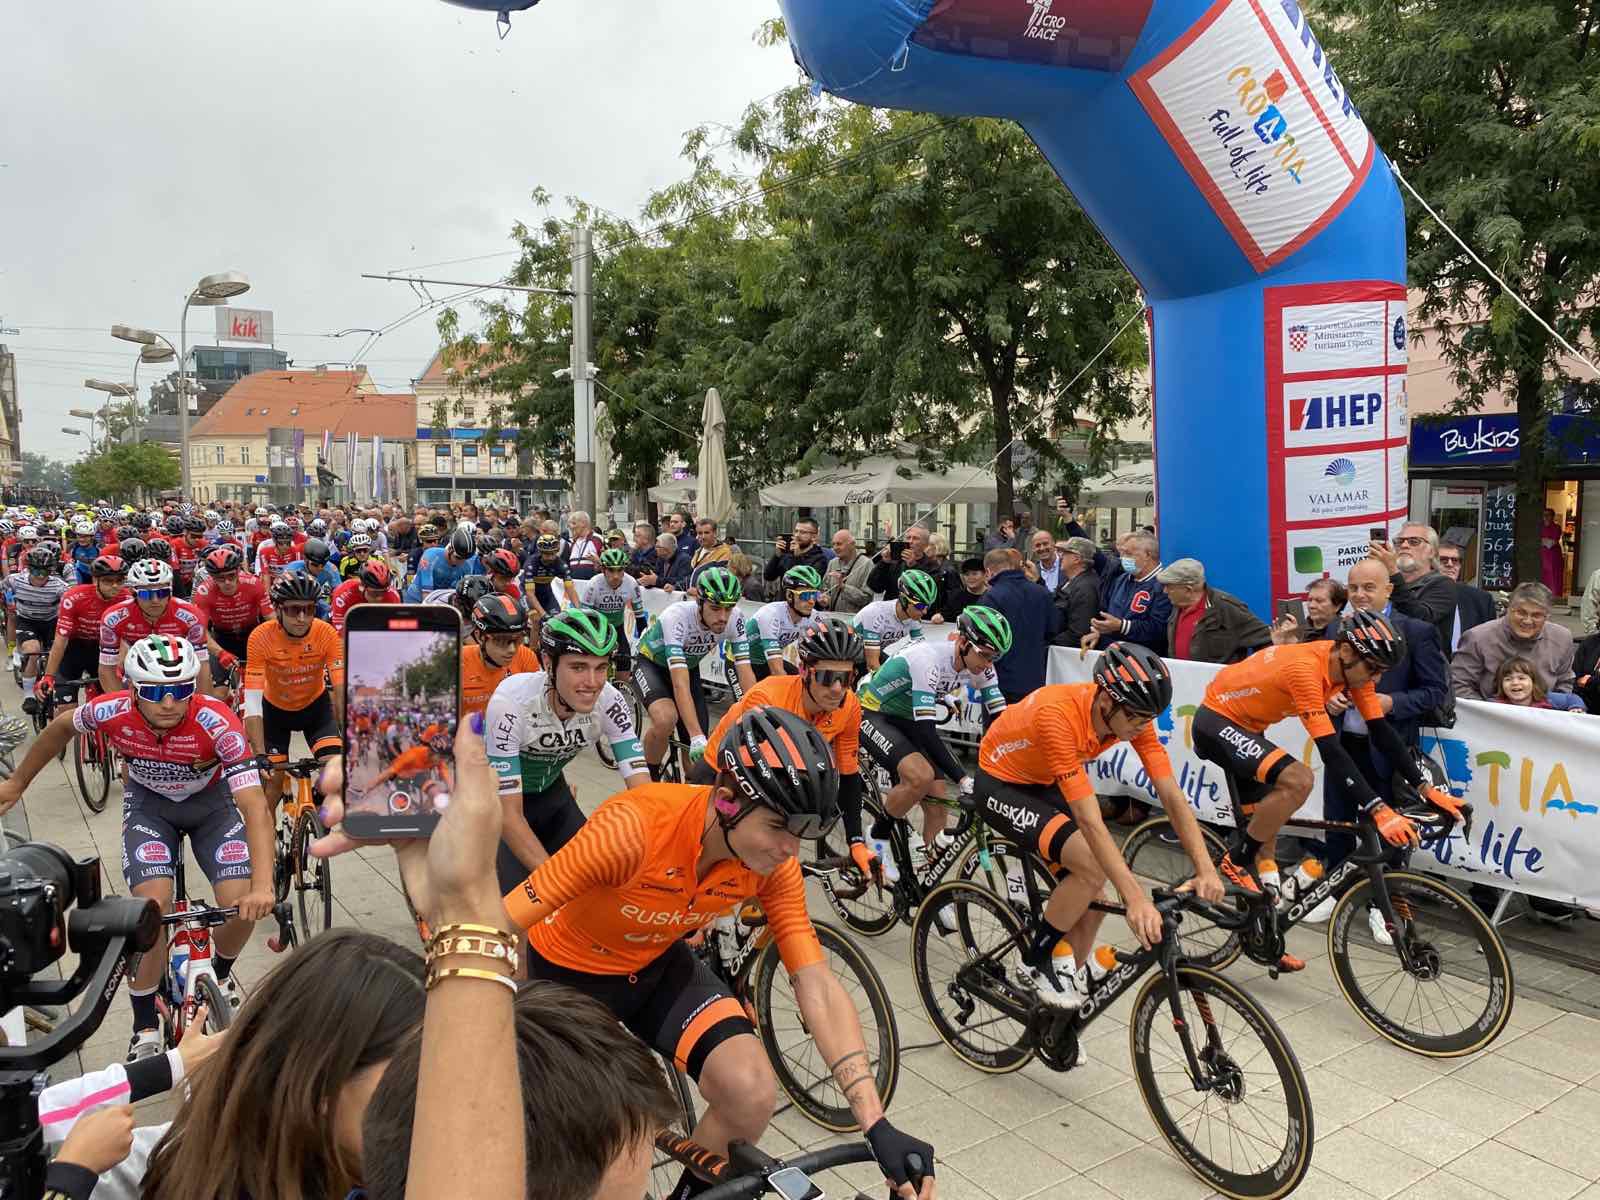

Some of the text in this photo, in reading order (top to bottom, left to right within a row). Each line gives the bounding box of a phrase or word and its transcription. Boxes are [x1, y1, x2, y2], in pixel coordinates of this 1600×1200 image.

[1028, 26, 1059, 40] RACE
[1042, 15, 1066, 28] CRO
[1203, 108, 1234, 149] Full
[1244, 164, 1270, 196] life
[231, 315, 258, 341] kik
[1326, 392, 1381, 428] HEP
[1309, 489, 1369, 506] VALAMAR
[1130, 591, 1151, 613] C
[96, 698, 130, 721] OMZ
[606, 702, 633, 734] RGA
[197, 711, 230, 737] OMZ
[496, 712, 518, 752] ALEA
[540, 729, 587, 748] CAJA
[132, 758, 191, 773] ANDRONI
[1480, 820, 1545, 880] life
[1009, 876, 1025, 894] 75
[1287, 861, 1359, 920] ORBEA
[104, 955, 126, 1001] RONIN
